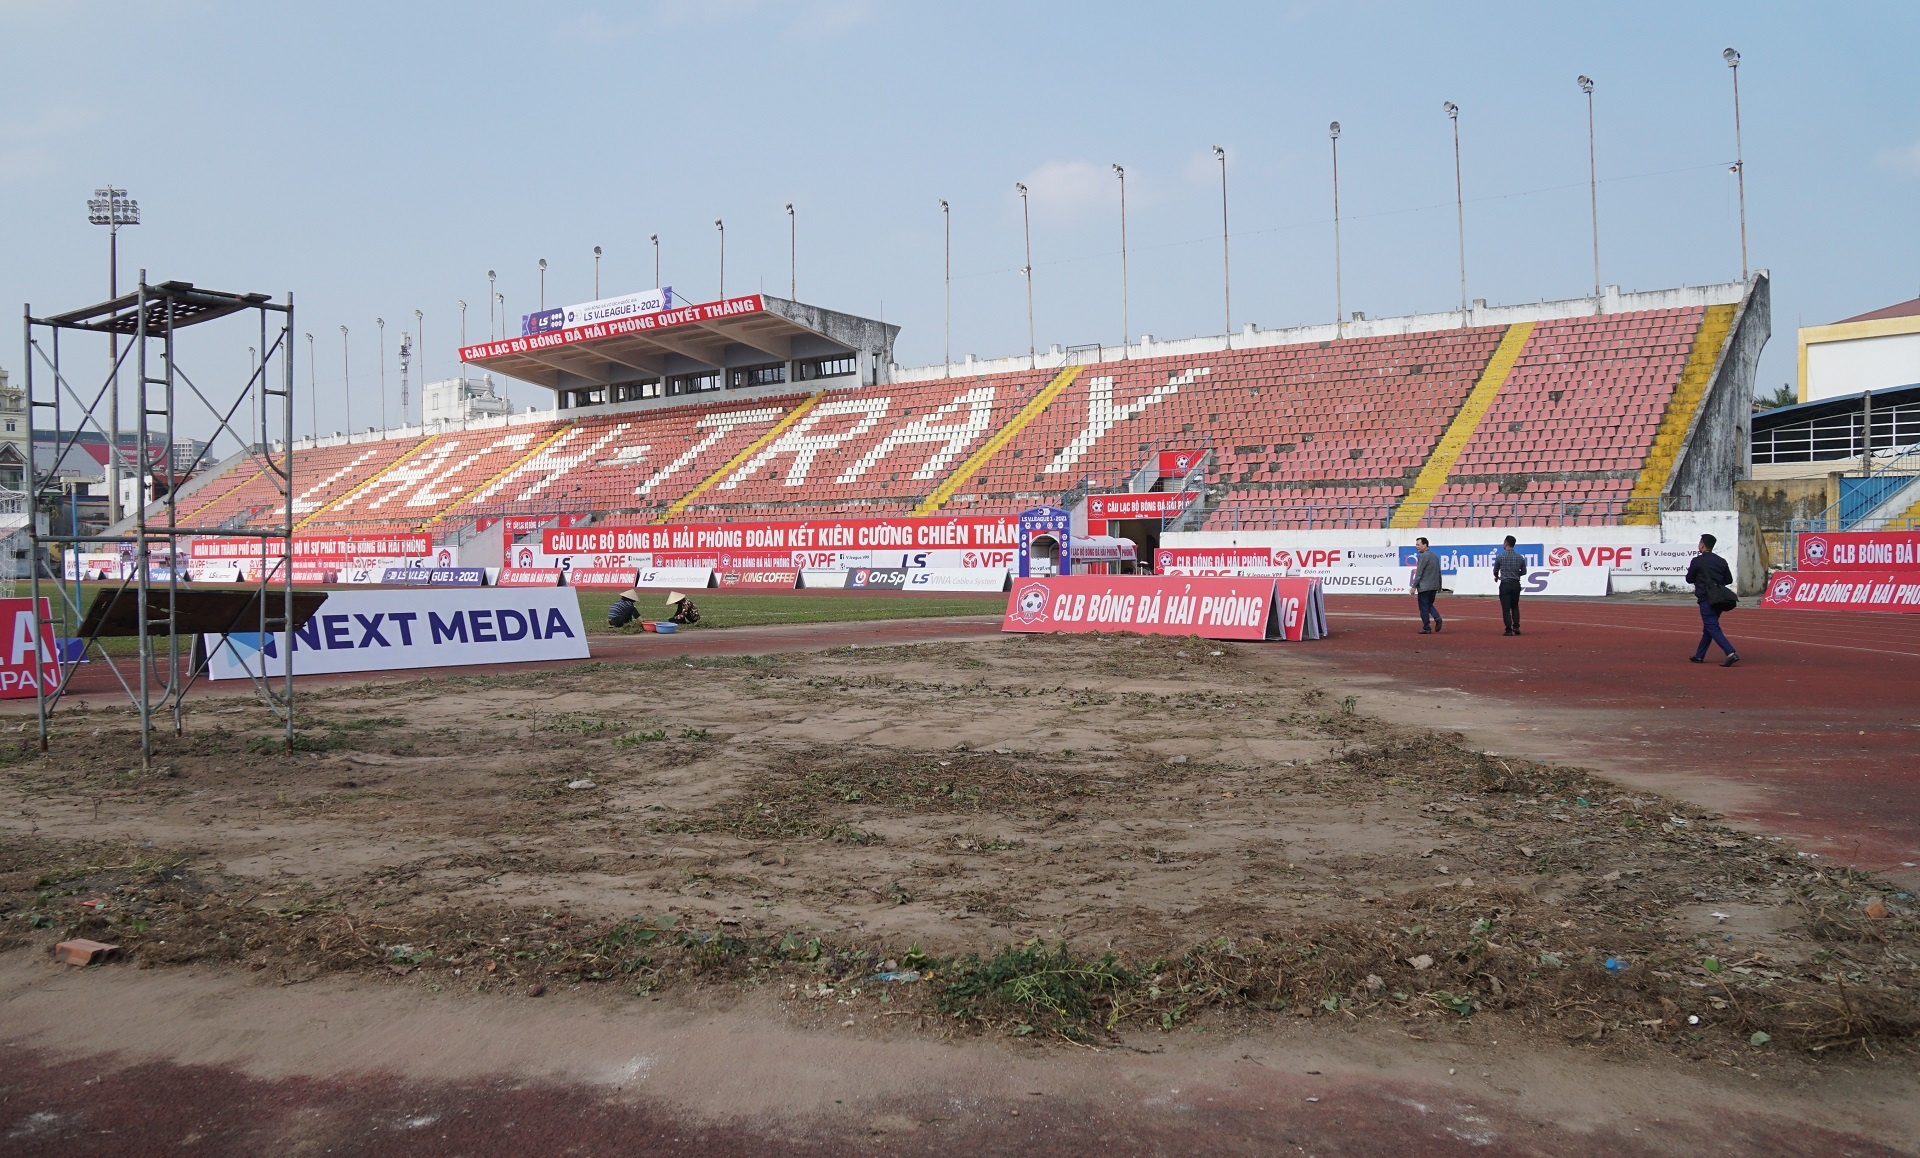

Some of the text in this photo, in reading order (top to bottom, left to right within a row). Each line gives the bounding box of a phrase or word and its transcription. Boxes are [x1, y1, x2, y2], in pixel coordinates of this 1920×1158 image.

[583, 312, 593, 321] LS
[594, 305, 631, 319] V.LEAGUE
[641, 299, 661, 311] 2021
[539, 317, 548, 327] LS
[464, 348, 487, 359] CÂU
[488, 343, 509, 356] LẠC
[511, 338, 528, 352] BỘ
[530, 335, 563, 348] BÓNG
[564, 328, 583, 341] ĐÁ
[584, 323, 607, 339] HẢI
[608, 316, 655, 334] PHÒNG
[657, 306, 701, 326] QUYẾT
[1107, 500, 1119, 513] CÂU
[1119, 501, 1131, 514] LẠC
[1131, 499, 1140, 514] BỘ
[1140, 499, 1156, 512] BÓNG
[1157, 499, 1166, 511] ĐÁ
[551, 517, 1019, 553] CÂU LẠC BỘ BÓNG ĐÁ HẢI PHÒNG ĐOÀN KẾT KIÊN CƯỜNG CHIẾN THẮN
[269, 542, 281, 555] TAY
[295, 539, 303, 557] HỘ
[303, 539, 310, 555] VÌ
[320, 538, 337, 554] PHÁT
[377, 537, 387, 553] ĐÁ
[388, 535, 400, 553] HẢI
[1833, 539, 1914, 564] CLB BÓNG ĐÁ
[604, 555, 626, 568] VPF
[808, 553, 836, 567] VPF
[902, 553, 927, 568] LS
[981, 552, 1014, 568] VPF
[1177, 550, 1268, 567] CLB BÓNG ĐÁ HẢI PHÒNG
[1296, 550, 1341, 567] VPF
[1473, 548, 1497, 568] HIỂ
[1577, 547, 1632, 568] VPF
[459, 571, 479, 581] 2021
[643, 572, 656, 582] LS
[742, 571, 764, 583] KING
[763, 571, 796, 583] COFFEE
[869, 571, 888, 583] On
[912, 572, 930, 584] LS
[930, 575, 951, 585] VINA
[952, 577, 970, 585] Cable
[974, 577, 997, 587] System
[1794, 582, 1819, 602] CLB
[1817, 579, 1854, 603] BÓNG
[1850, 579, 1874, 604] ĐÁ
[1869, 575, 1896, 604] HẢI
[1053, 583, 1263, 627] CLB BÓNG ĐÁ HẢI PHÒNG
[291, 607, 576, 652] NEXT MEDIA
